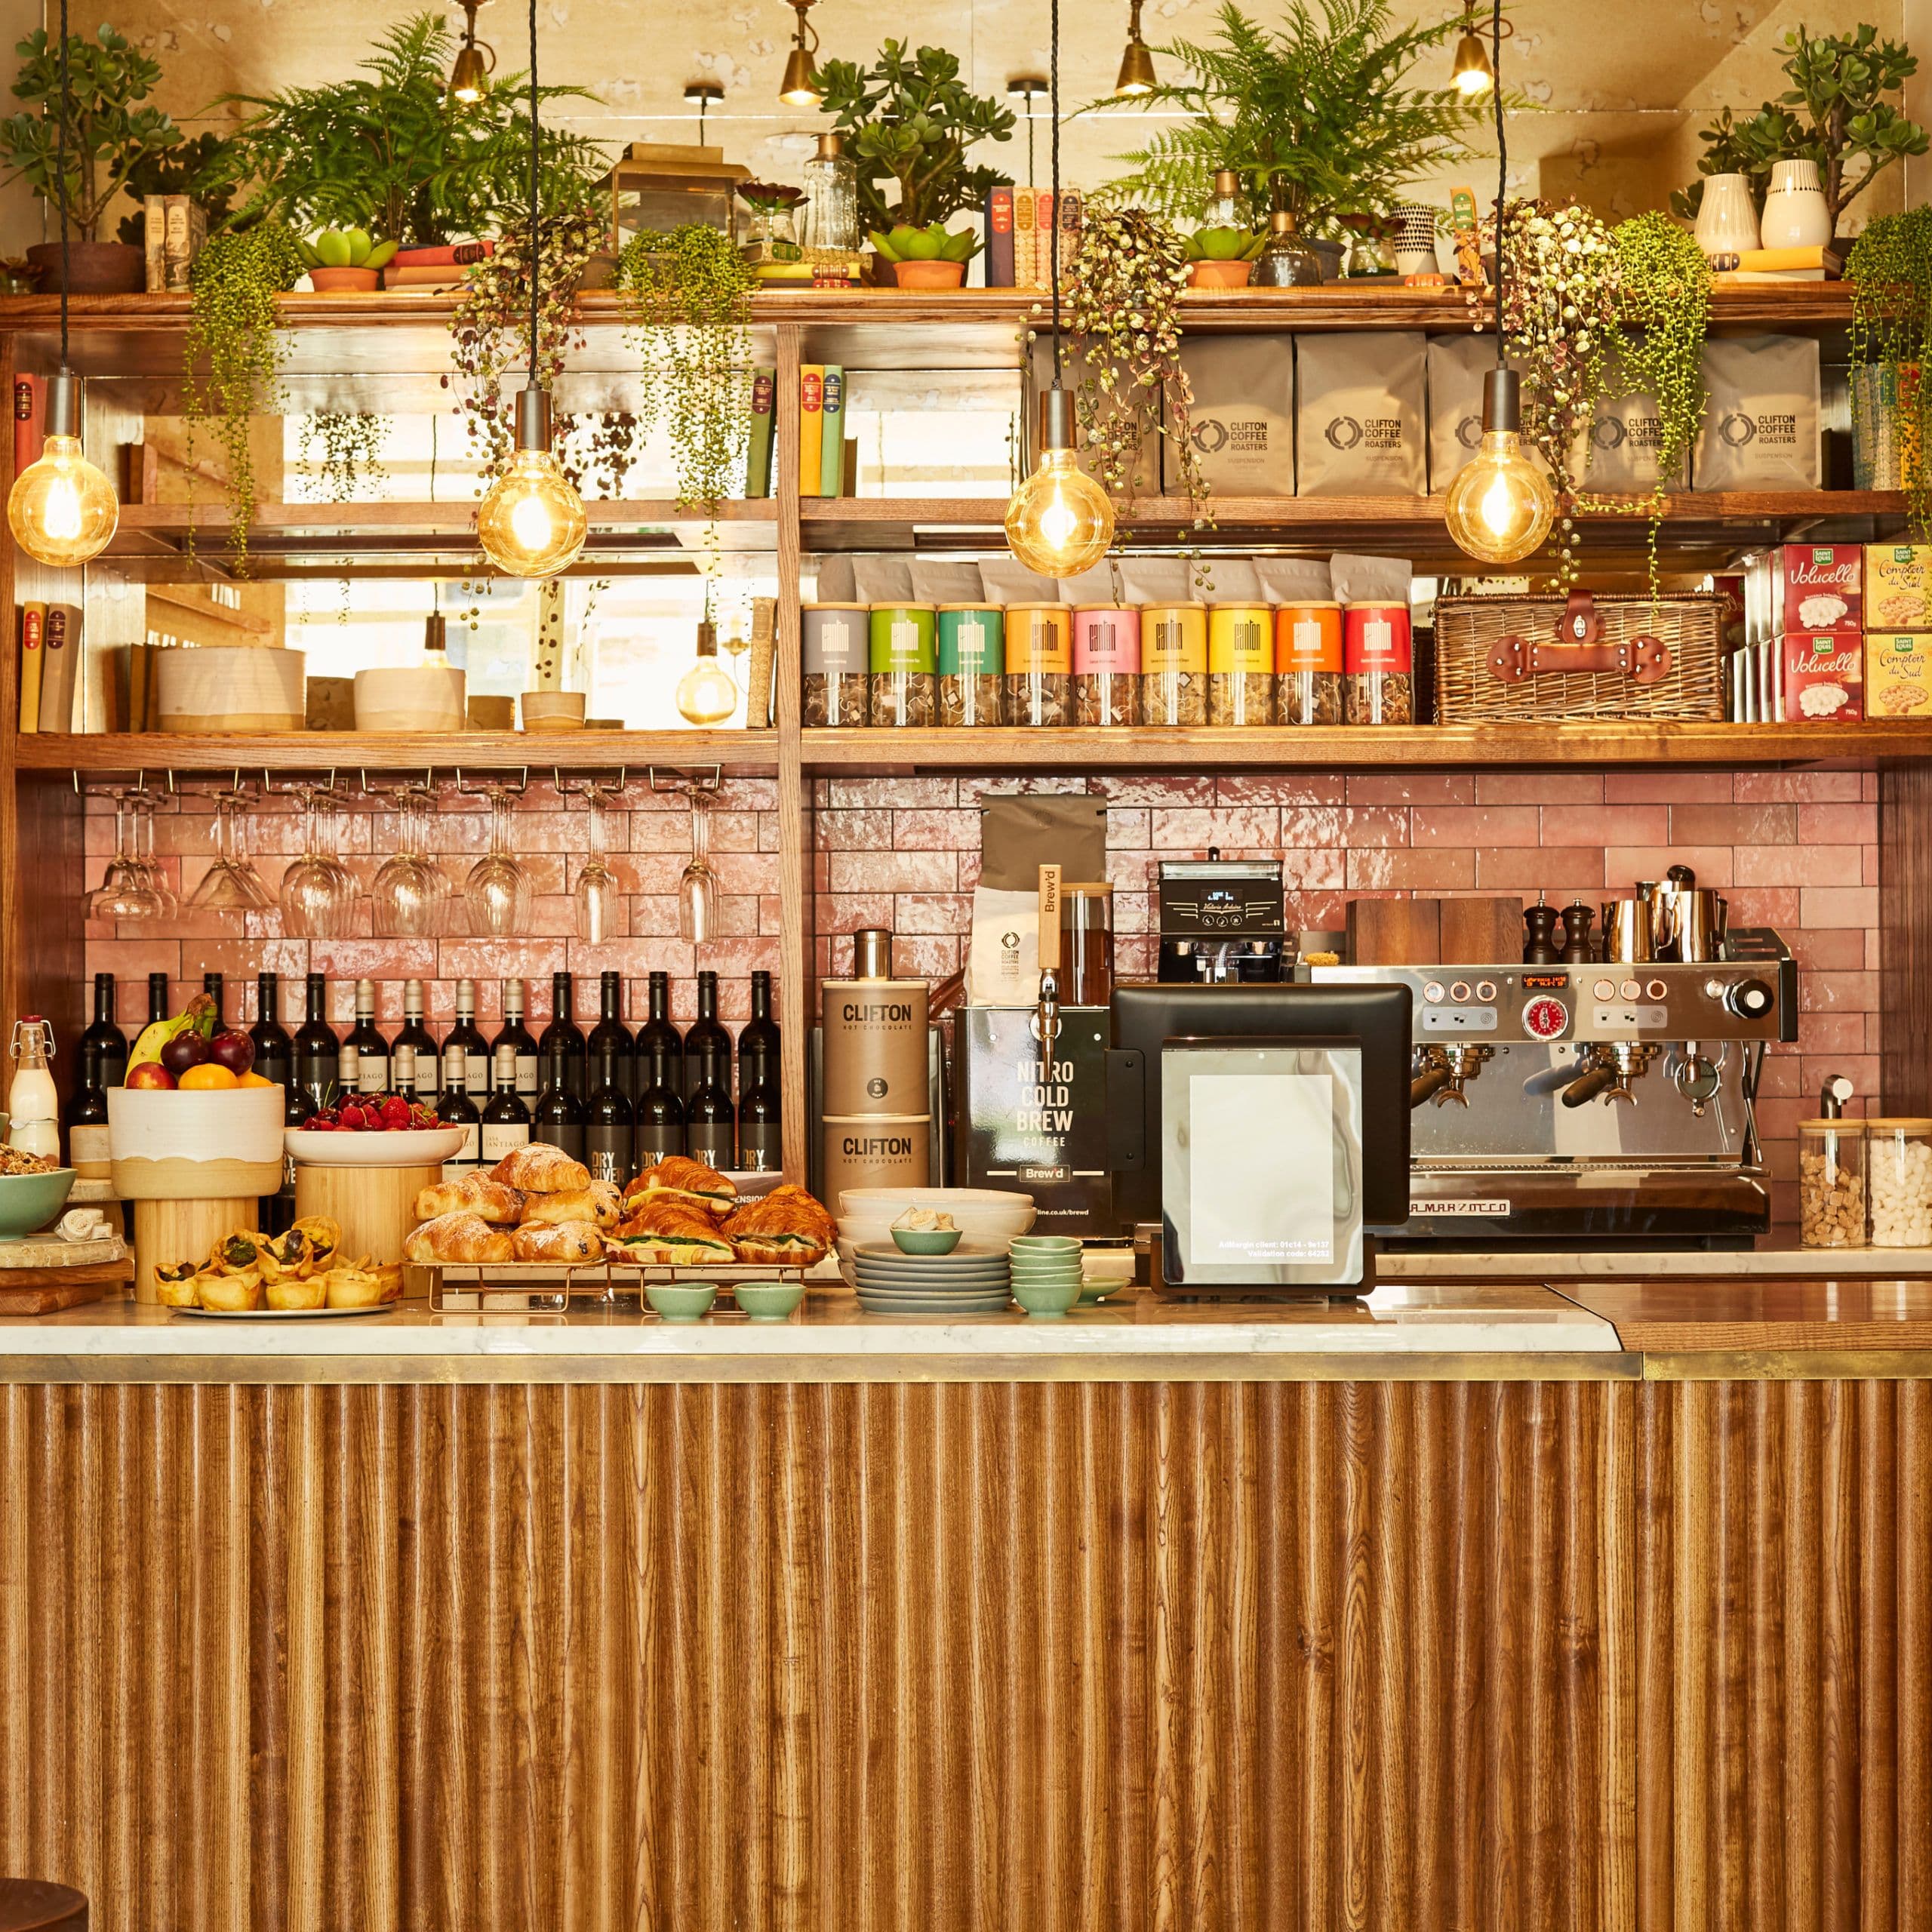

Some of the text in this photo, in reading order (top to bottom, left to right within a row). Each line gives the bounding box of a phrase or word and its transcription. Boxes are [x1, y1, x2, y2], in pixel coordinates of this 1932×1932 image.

[1230, 422, 1267, 431] CLIFTON
[1364, 419, 1401, 429] CLIFTON
[1758, 415, 1795, 424] CLIFTON
[1230, 432, 1267, 441] COFFEE
[1364, 429, 1401, 438] COFFEE
[1758, 425, 1795, 434] COFFEE
[1880, 648, 1926, 667] Comptoir
[1889, 665, 1921, 679] du Sud
[1044, 871, 1055, 912] Brew'd
[843, 1004, 912, 1021] CLIFTON
[1017, 1061, 1074, 1082] NITRO
[1021, 1086, 1069, 1107] COLD
[1017, 1110, 1073, 1131] BREW
[843, 1138, 912, 1155] CLIFTON
[1023, 1137, 1066, 1146] COFFEE
[592, 1152, 615, 1168] DRY
[592, 1168, 624, 1183] RIVER
[1026, 1168, 1063, 1178] Brew'd
